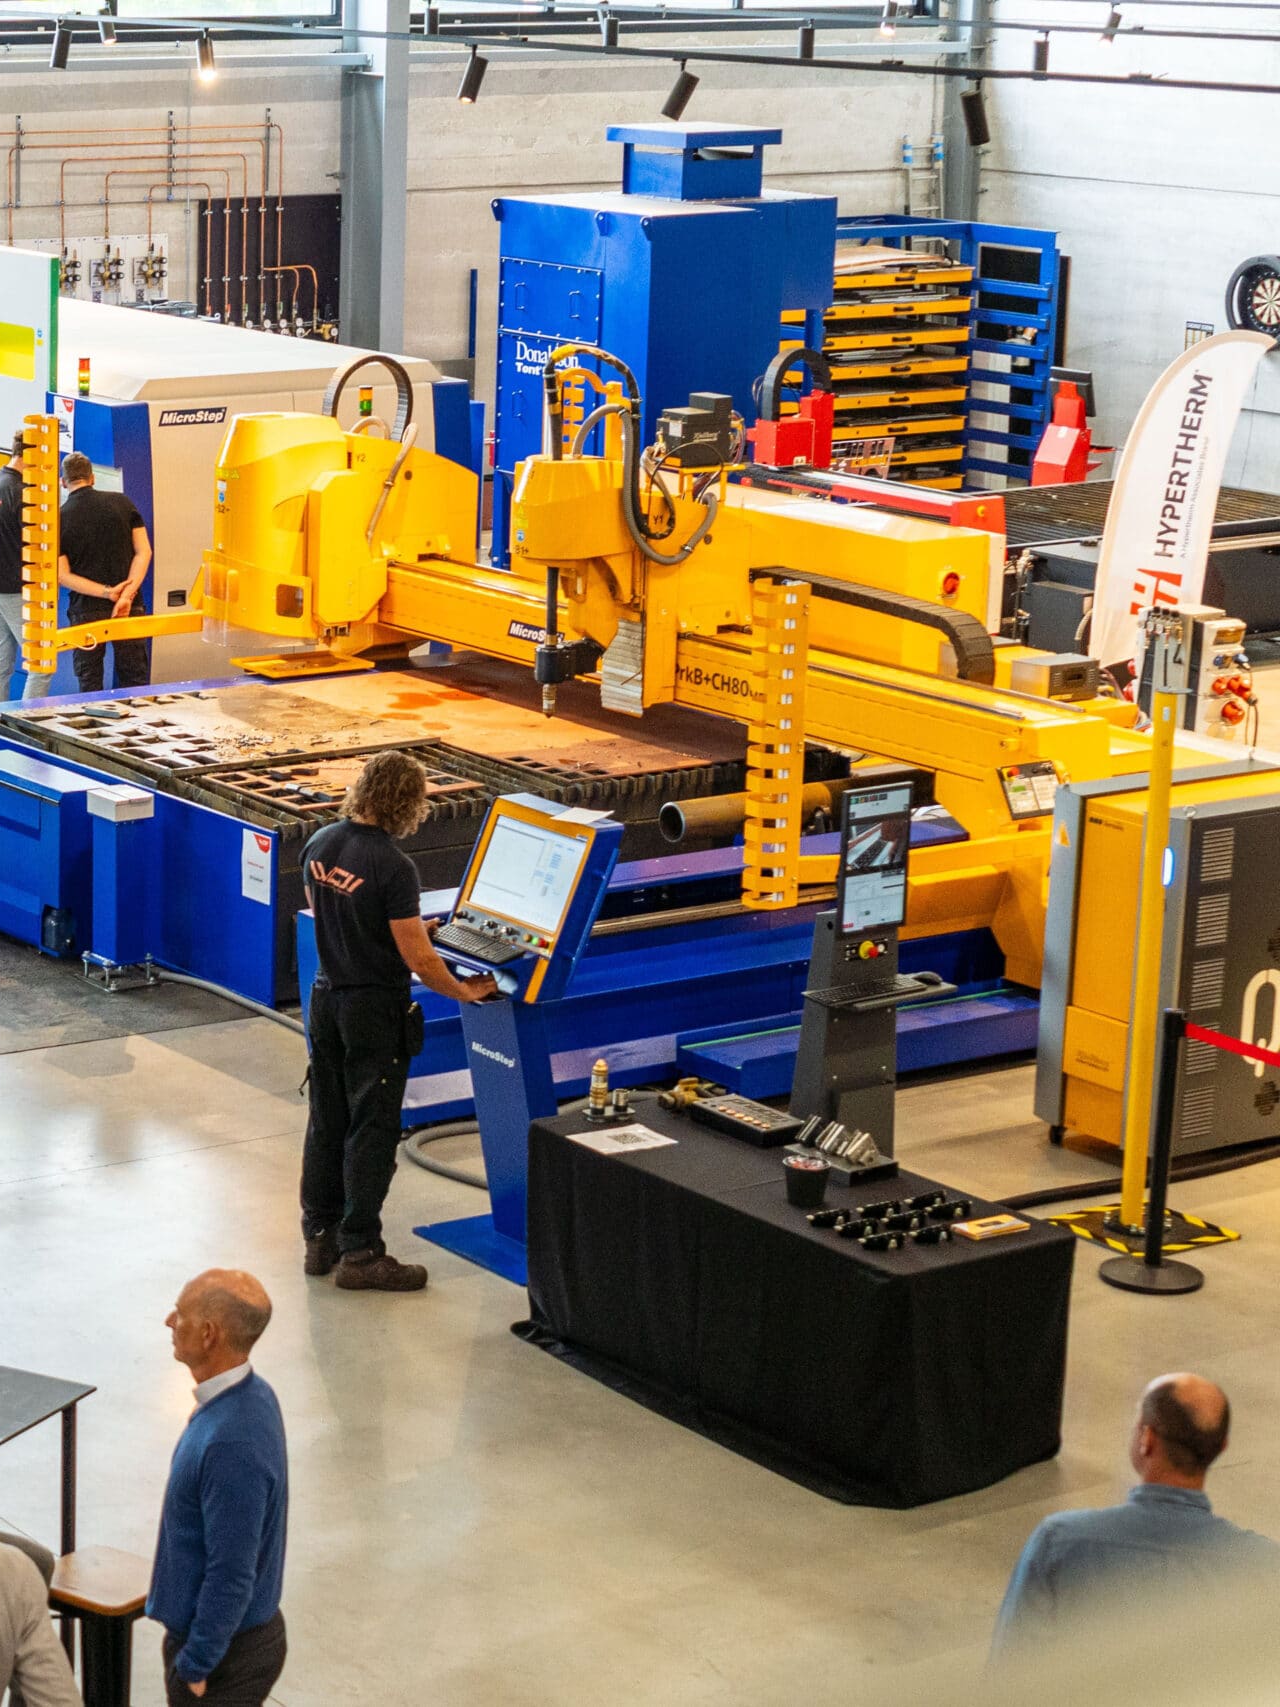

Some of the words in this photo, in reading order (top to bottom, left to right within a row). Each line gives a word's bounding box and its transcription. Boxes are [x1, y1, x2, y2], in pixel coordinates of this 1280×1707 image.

[161, 410, 224, 425] MicroStep
[1154, 373, 1213, 558] HYPERTHERM
[509, 622, 564, 644] MicroS
[472, 1041, 516, 1068] MicroStep
